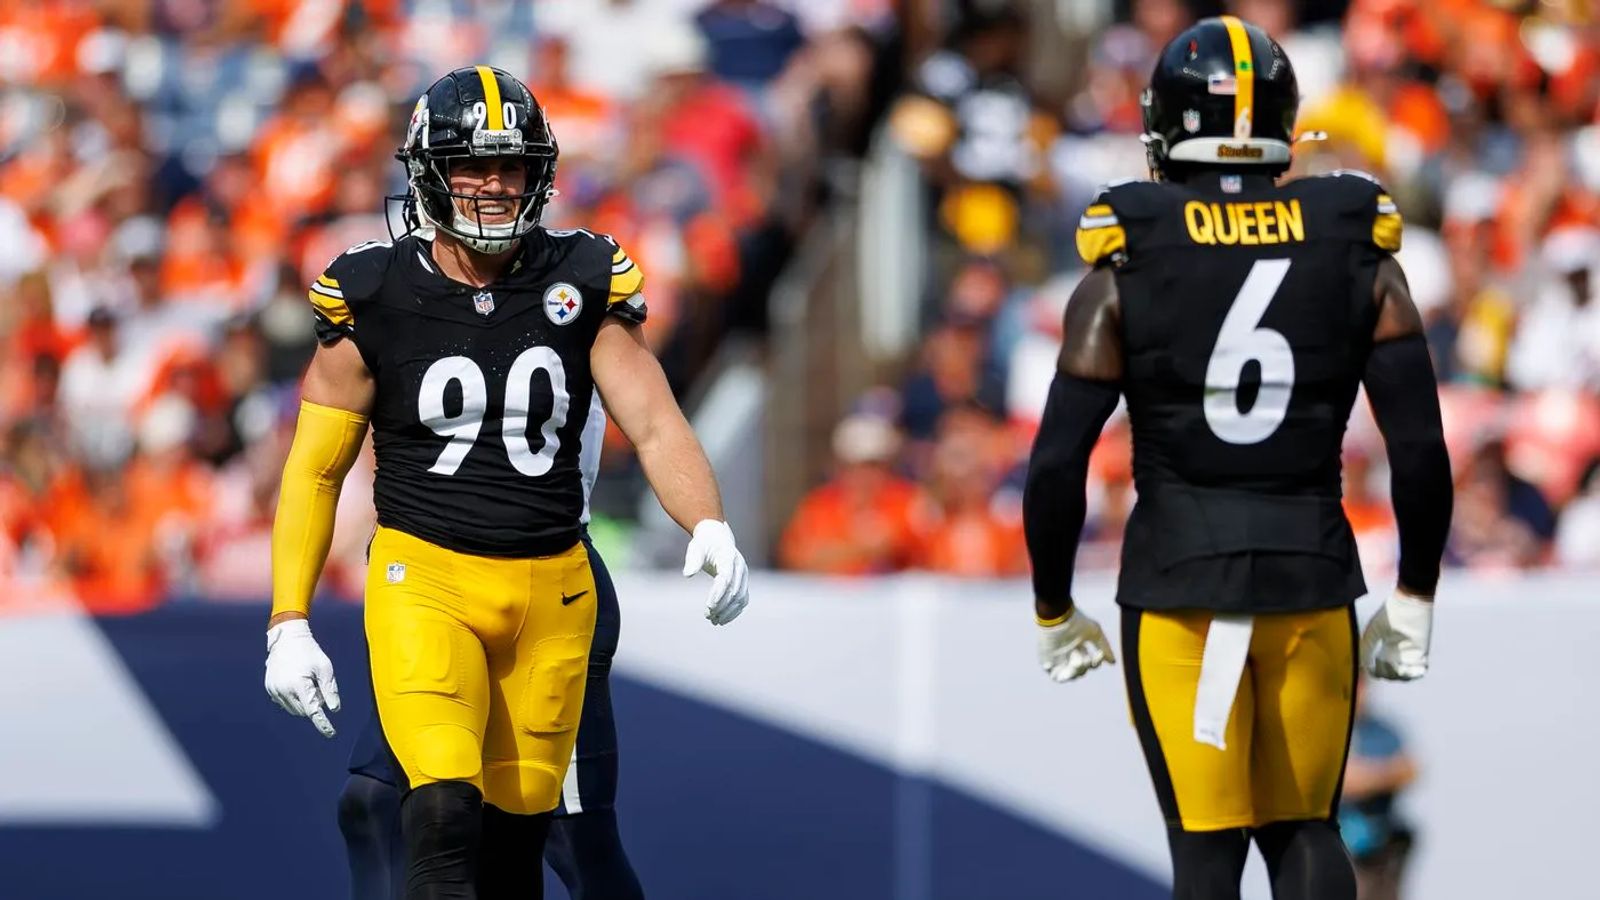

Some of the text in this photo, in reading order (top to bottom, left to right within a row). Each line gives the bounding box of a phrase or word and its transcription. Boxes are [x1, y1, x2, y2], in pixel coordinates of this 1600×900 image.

[472, 101, 517, 131] 90
[1184, 199, 1305, 245] QUEEN
[1203, 258, 1295, 445] 6
[418, 346, 570, 477] 90
